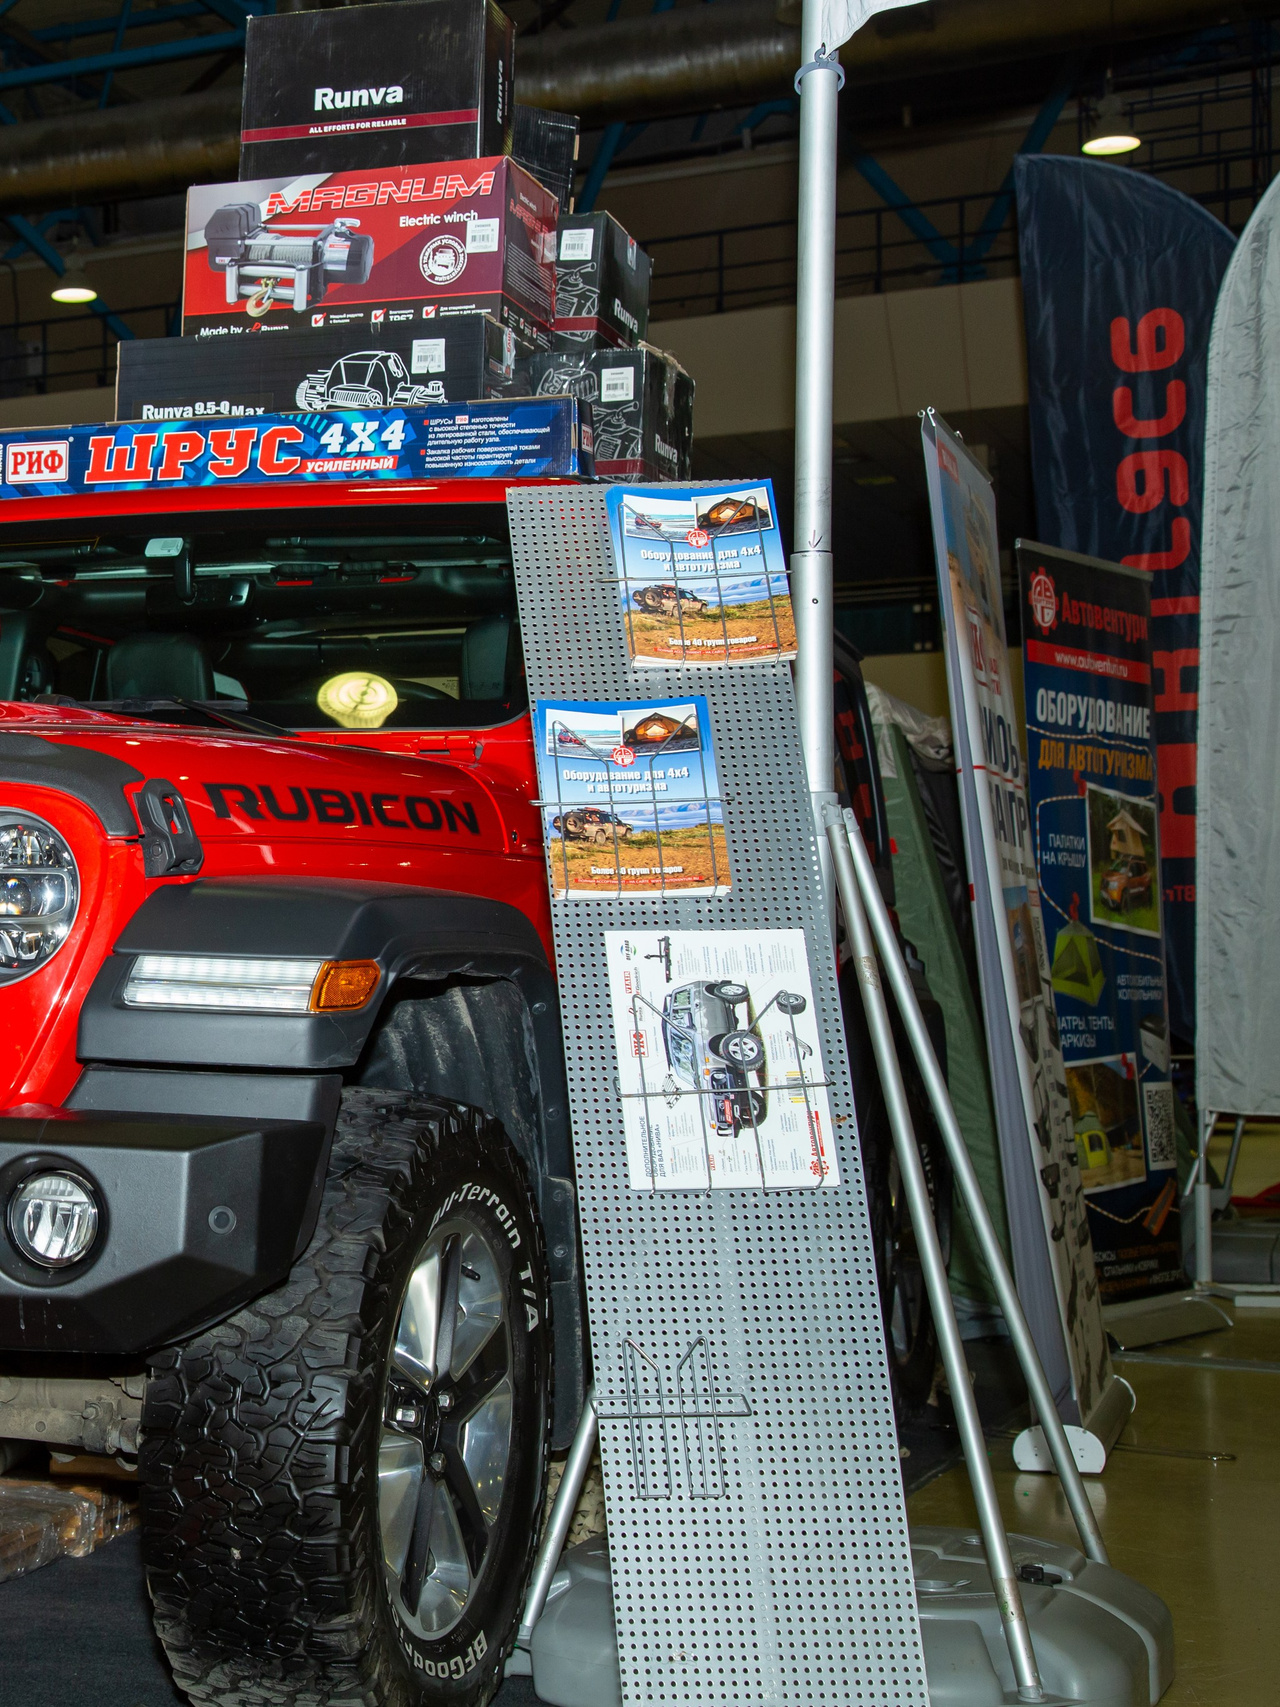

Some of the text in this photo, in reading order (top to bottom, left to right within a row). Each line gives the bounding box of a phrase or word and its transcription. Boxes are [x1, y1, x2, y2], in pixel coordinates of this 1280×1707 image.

[314, 85, 404, 111] Runva
[309, 118, 407, 134] ALL EFFORTS FOR RELIABLE
[266, 171, 496, 216] MAGNUM
[399, 210, 478, 227] Electric winch
[614, 298, 638, 333] Runva
[200, 326, 228, 336] Made
[230, 325, 243, 334] by
[142, 401, 266, 420] Runva 9.5-Q Max
[430, 418, 453, 426] ШРУСы
[434, 424, 458, 432] высокой
[460, 423, 488, 431] степенью
[436, 430, 477, 439] легированной
[478, 429, 497, 437] стали,
[498, 426, 550, 436] обеспечивающей
[427, 438, 463, 446] длительную
[464, 437, 484, 445] работу
[654, 434, 678, 463] Runva
[84, 425, 304, 484] ШРУС
[426, 454, 450, 462] высокой
[476, 452, 512, 460] гарантирует
[427, 448, 451, 456] Закалка
[451, 447, 476, 455] рабочих
[477, 445, 518, 453] поверхностей
[11, 450, 64, 476] РИФ
[305, 456, 394, 472] УСИЛЕННЫЙ
[464, 459, 513, 467] износостойкость
[718, 548, 738, 559] для
[664, 563, 671, 571] и
[1062, 592, 1148, 643] Автовентури
[692, 637, 702, 646] 40
[727, 635, 757, 644] товаров
[1036, 688, 1150, 739] ОБОРУДОВАНИЕ
[1038, 738, 1065, 770] ДЛЯ
[1068, 744, 1153, 780] АВТОТУРИЗМА
[587, 785, 594, 793] и
[202, 783, 480, 834] RUBICON
[1049, 833, 1086, 850] ПАЛАТКИ
[1042, 851, 1056, 865] НА
[1059, 853, 1087, 868] КРЫШУ
[627, 867, 650, 875] групп
[1060, 1034, 1096, 1049] АРКИЗЫ
[639, 1116, 652, 1178] ДОПОЛНИТЕЛЬНОЕ
[658, 1163, 666, 1178] ДЛЯ
[427, 1182, 539, 1332] All-Terrain T/A
